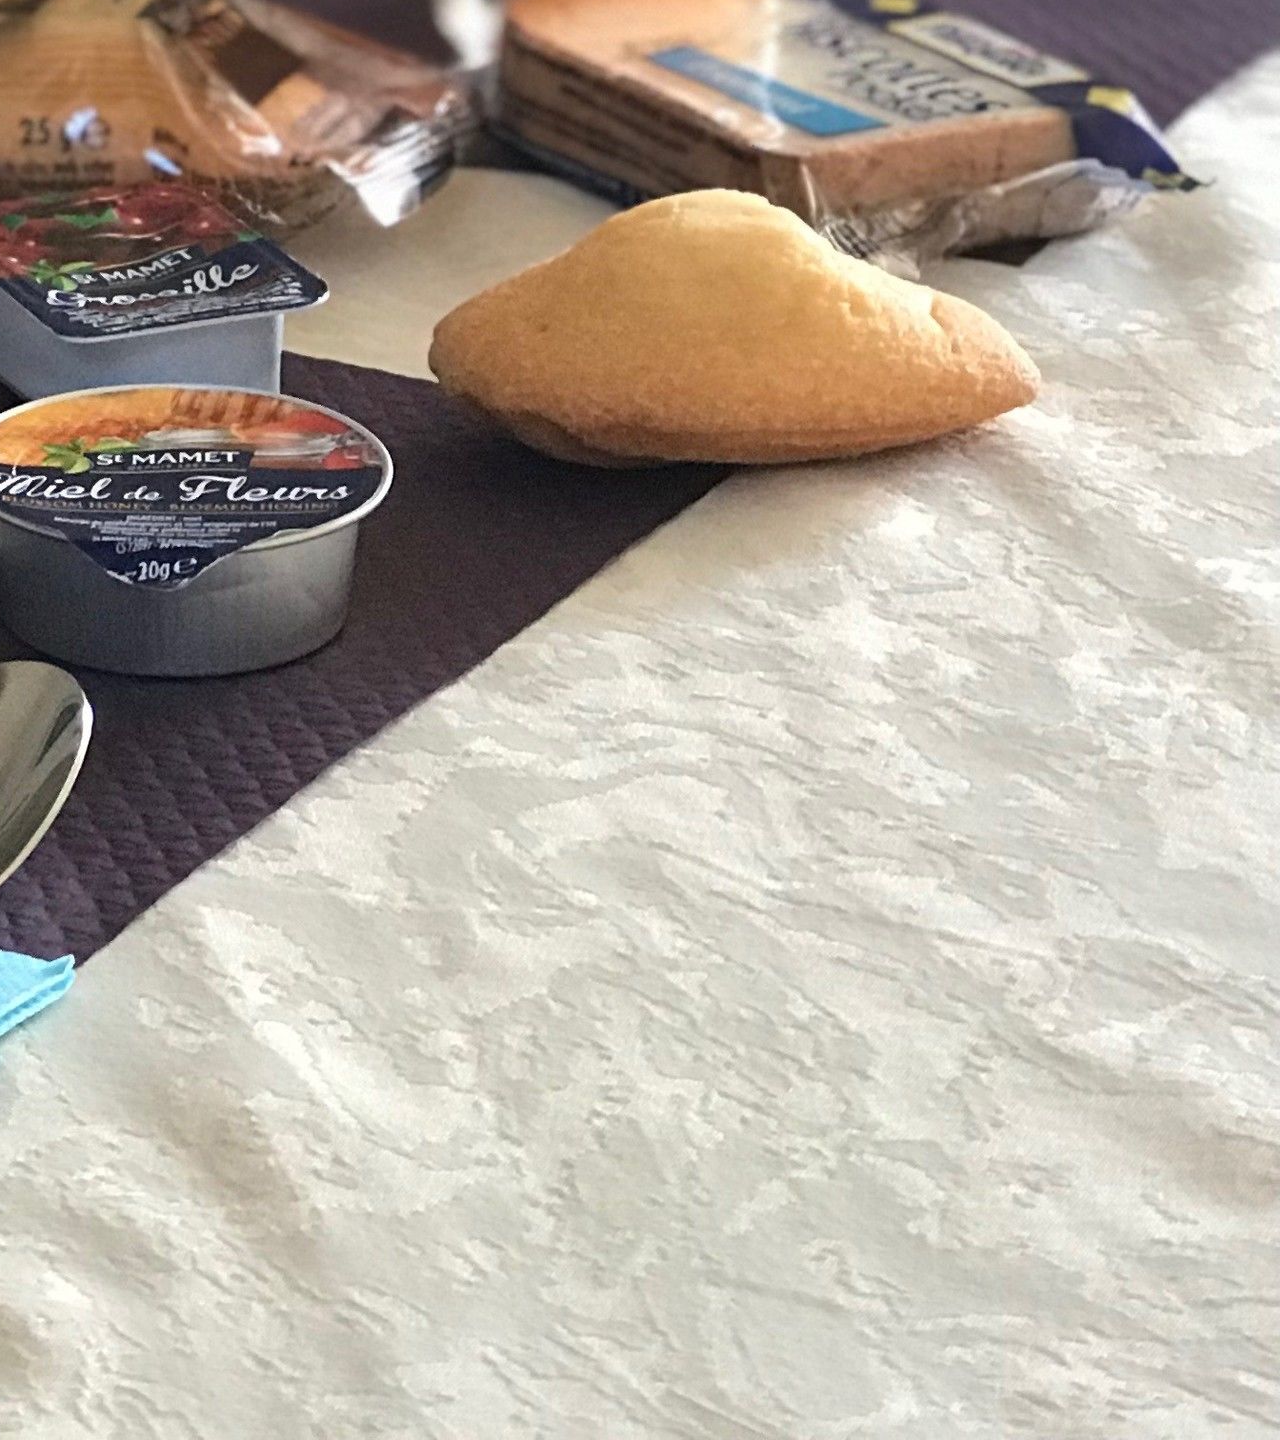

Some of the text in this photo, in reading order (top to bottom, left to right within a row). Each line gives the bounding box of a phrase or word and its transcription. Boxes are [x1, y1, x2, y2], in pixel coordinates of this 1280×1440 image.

[100, 247, 193, 282] MAMET
[131, 450, 240, 465] MAMET
[123, 485, 164, 502] de
[178, 474, 354, 502] Fleurs
